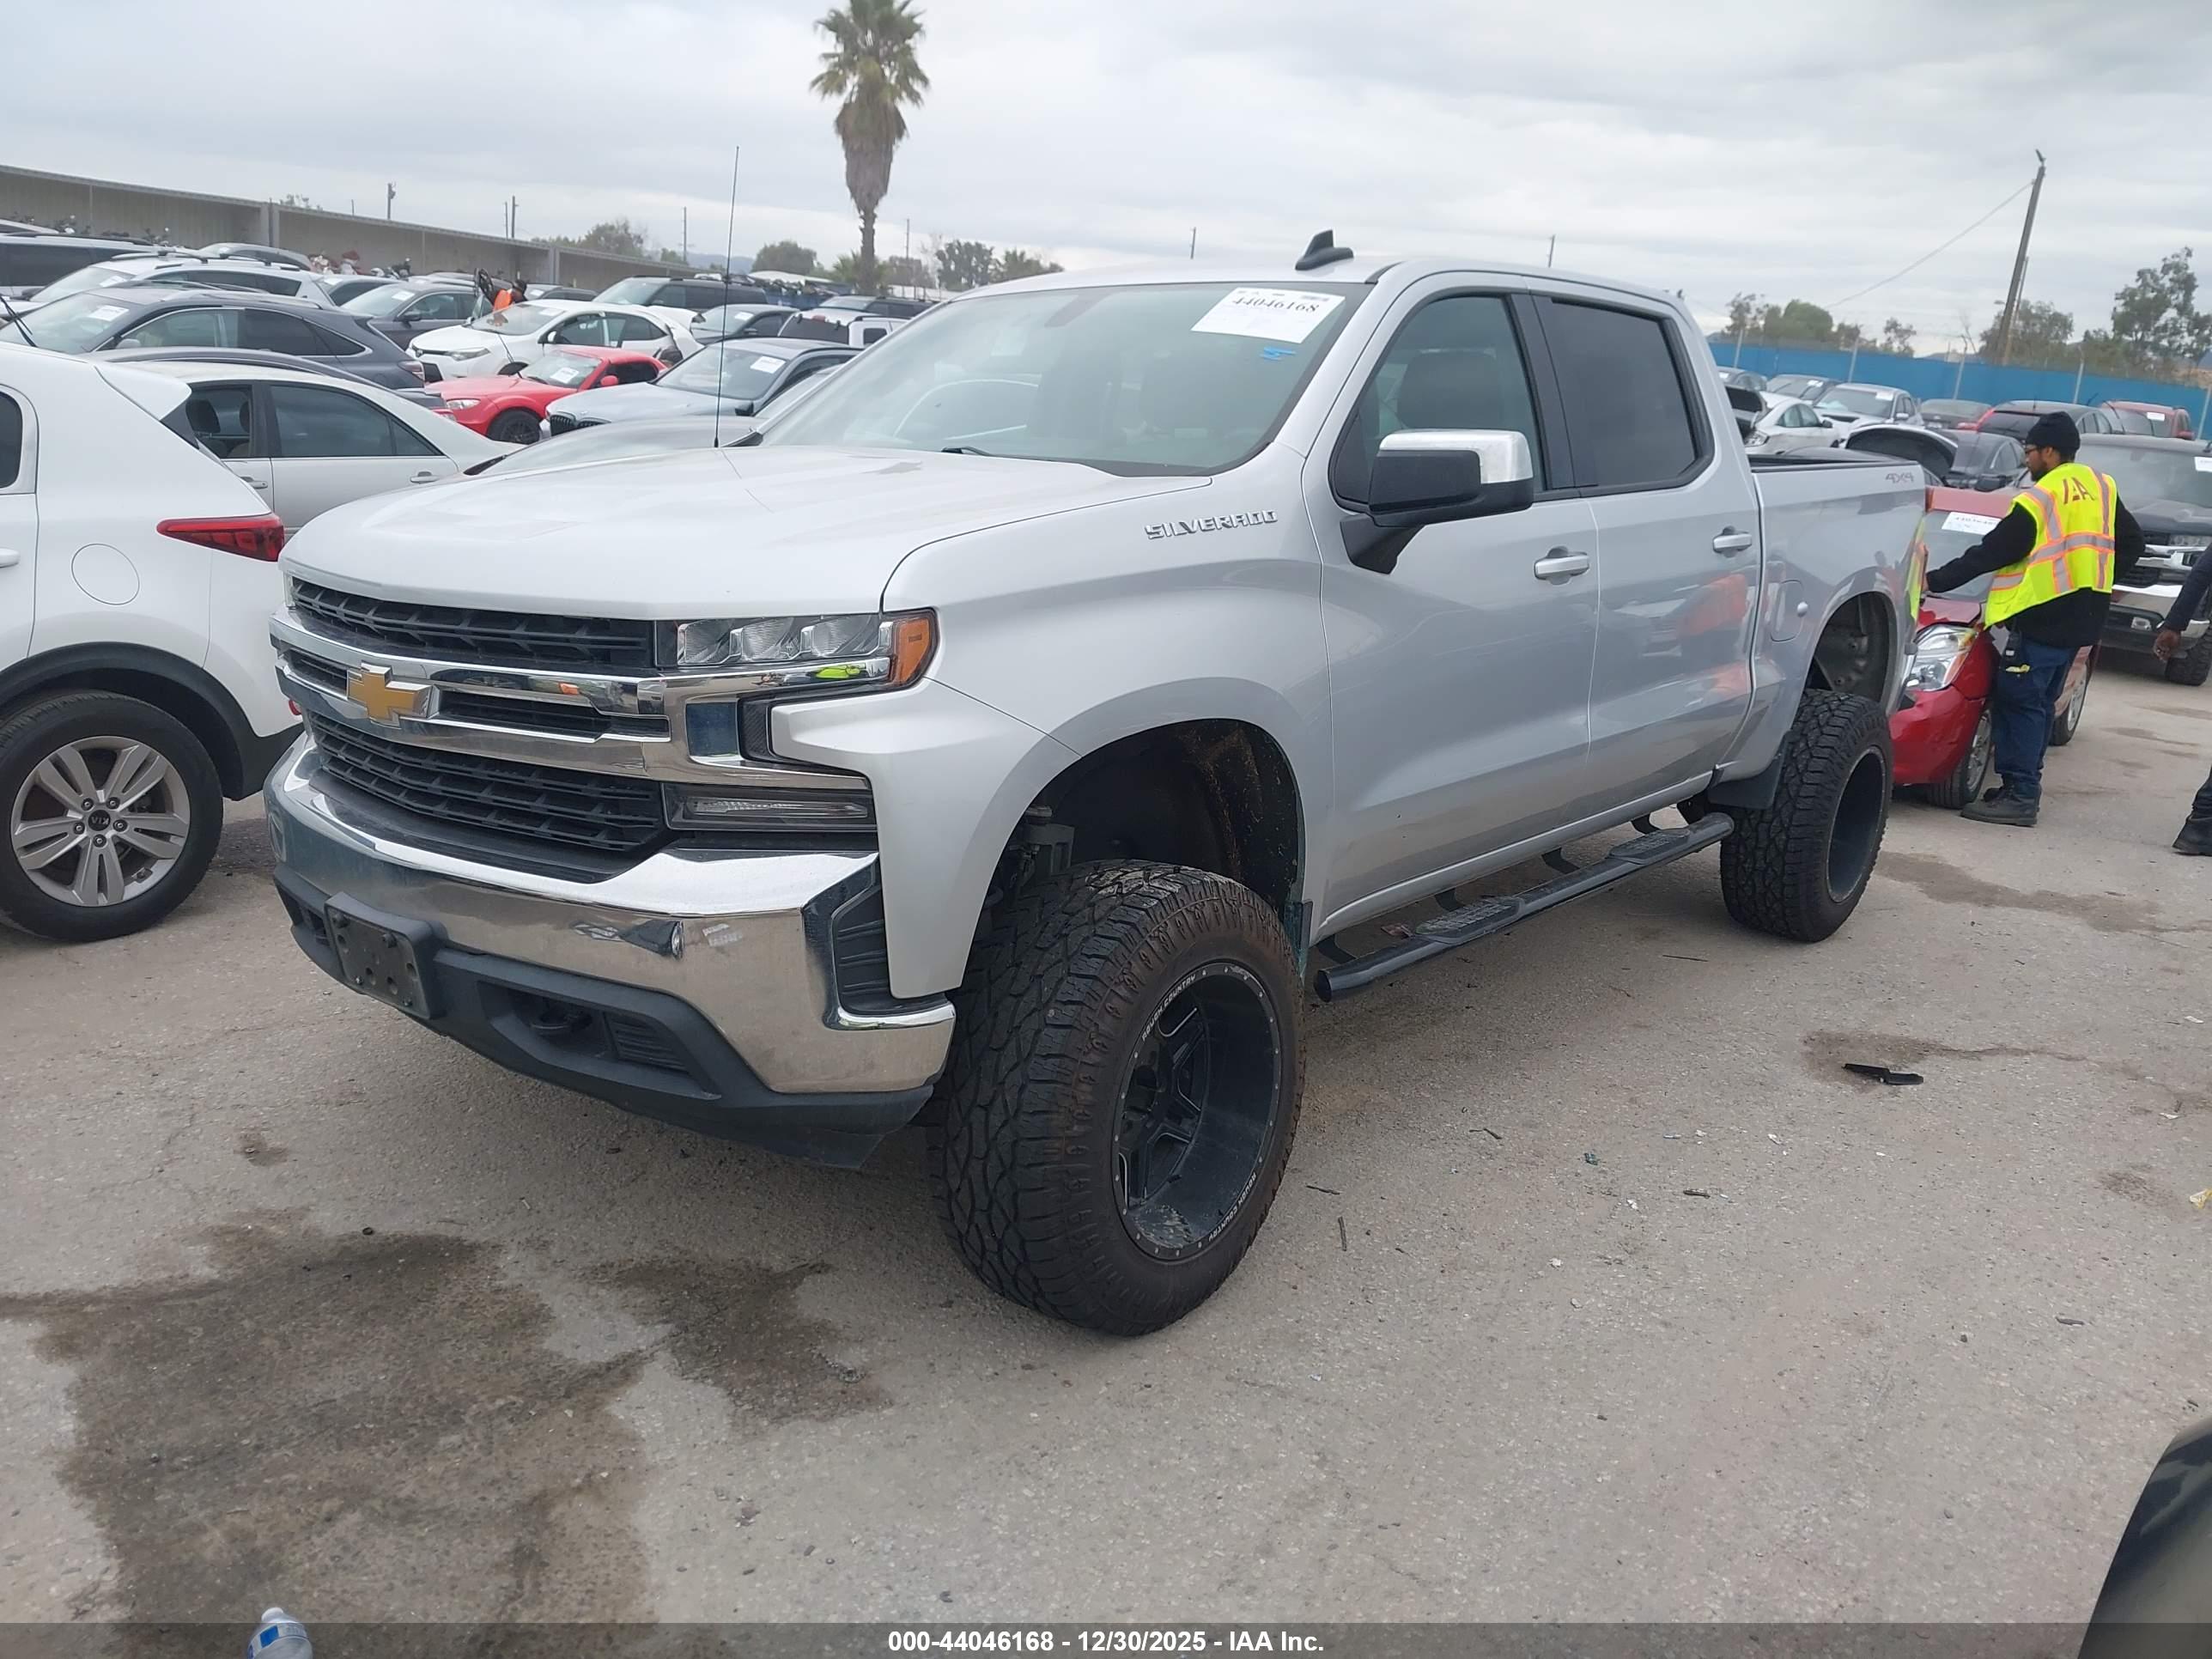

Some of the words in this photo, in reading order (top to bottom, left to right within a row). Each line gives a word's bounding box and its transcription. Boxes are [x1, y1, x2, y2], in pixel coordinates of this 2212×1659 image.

[1231, 295, 1321, 313] 44046168
[1144, 508, 1279, 540] SILVERADO
[1163, 975, 1196, 1008] COUNTRY
